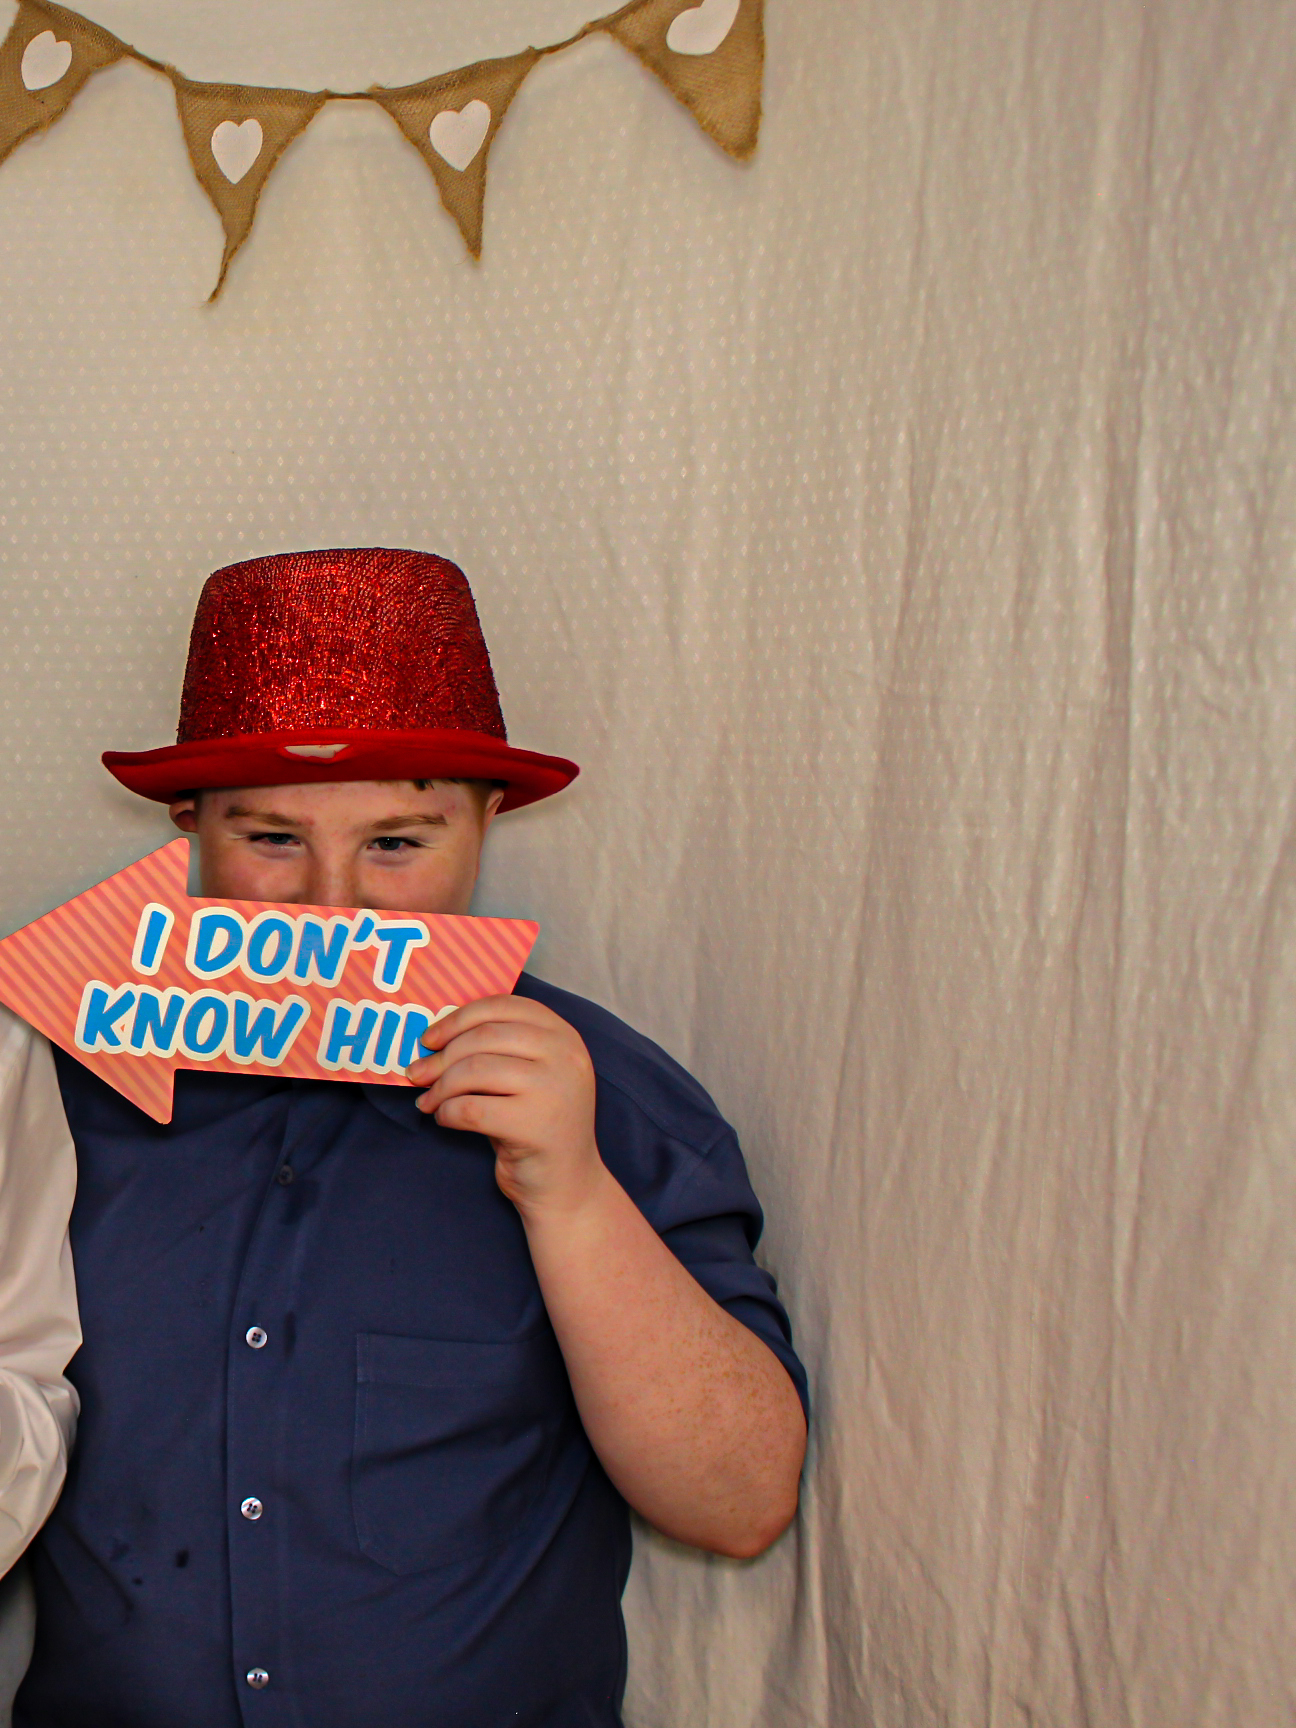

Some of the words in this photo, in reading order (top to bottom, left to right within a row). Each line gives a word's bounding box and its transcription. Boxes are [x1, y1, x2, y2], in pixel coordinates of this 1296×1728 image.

[138, 907, 170, 971] I
[193, 912, 425, 988] DON'T
[81, 986, 307, 1065] KNOW
